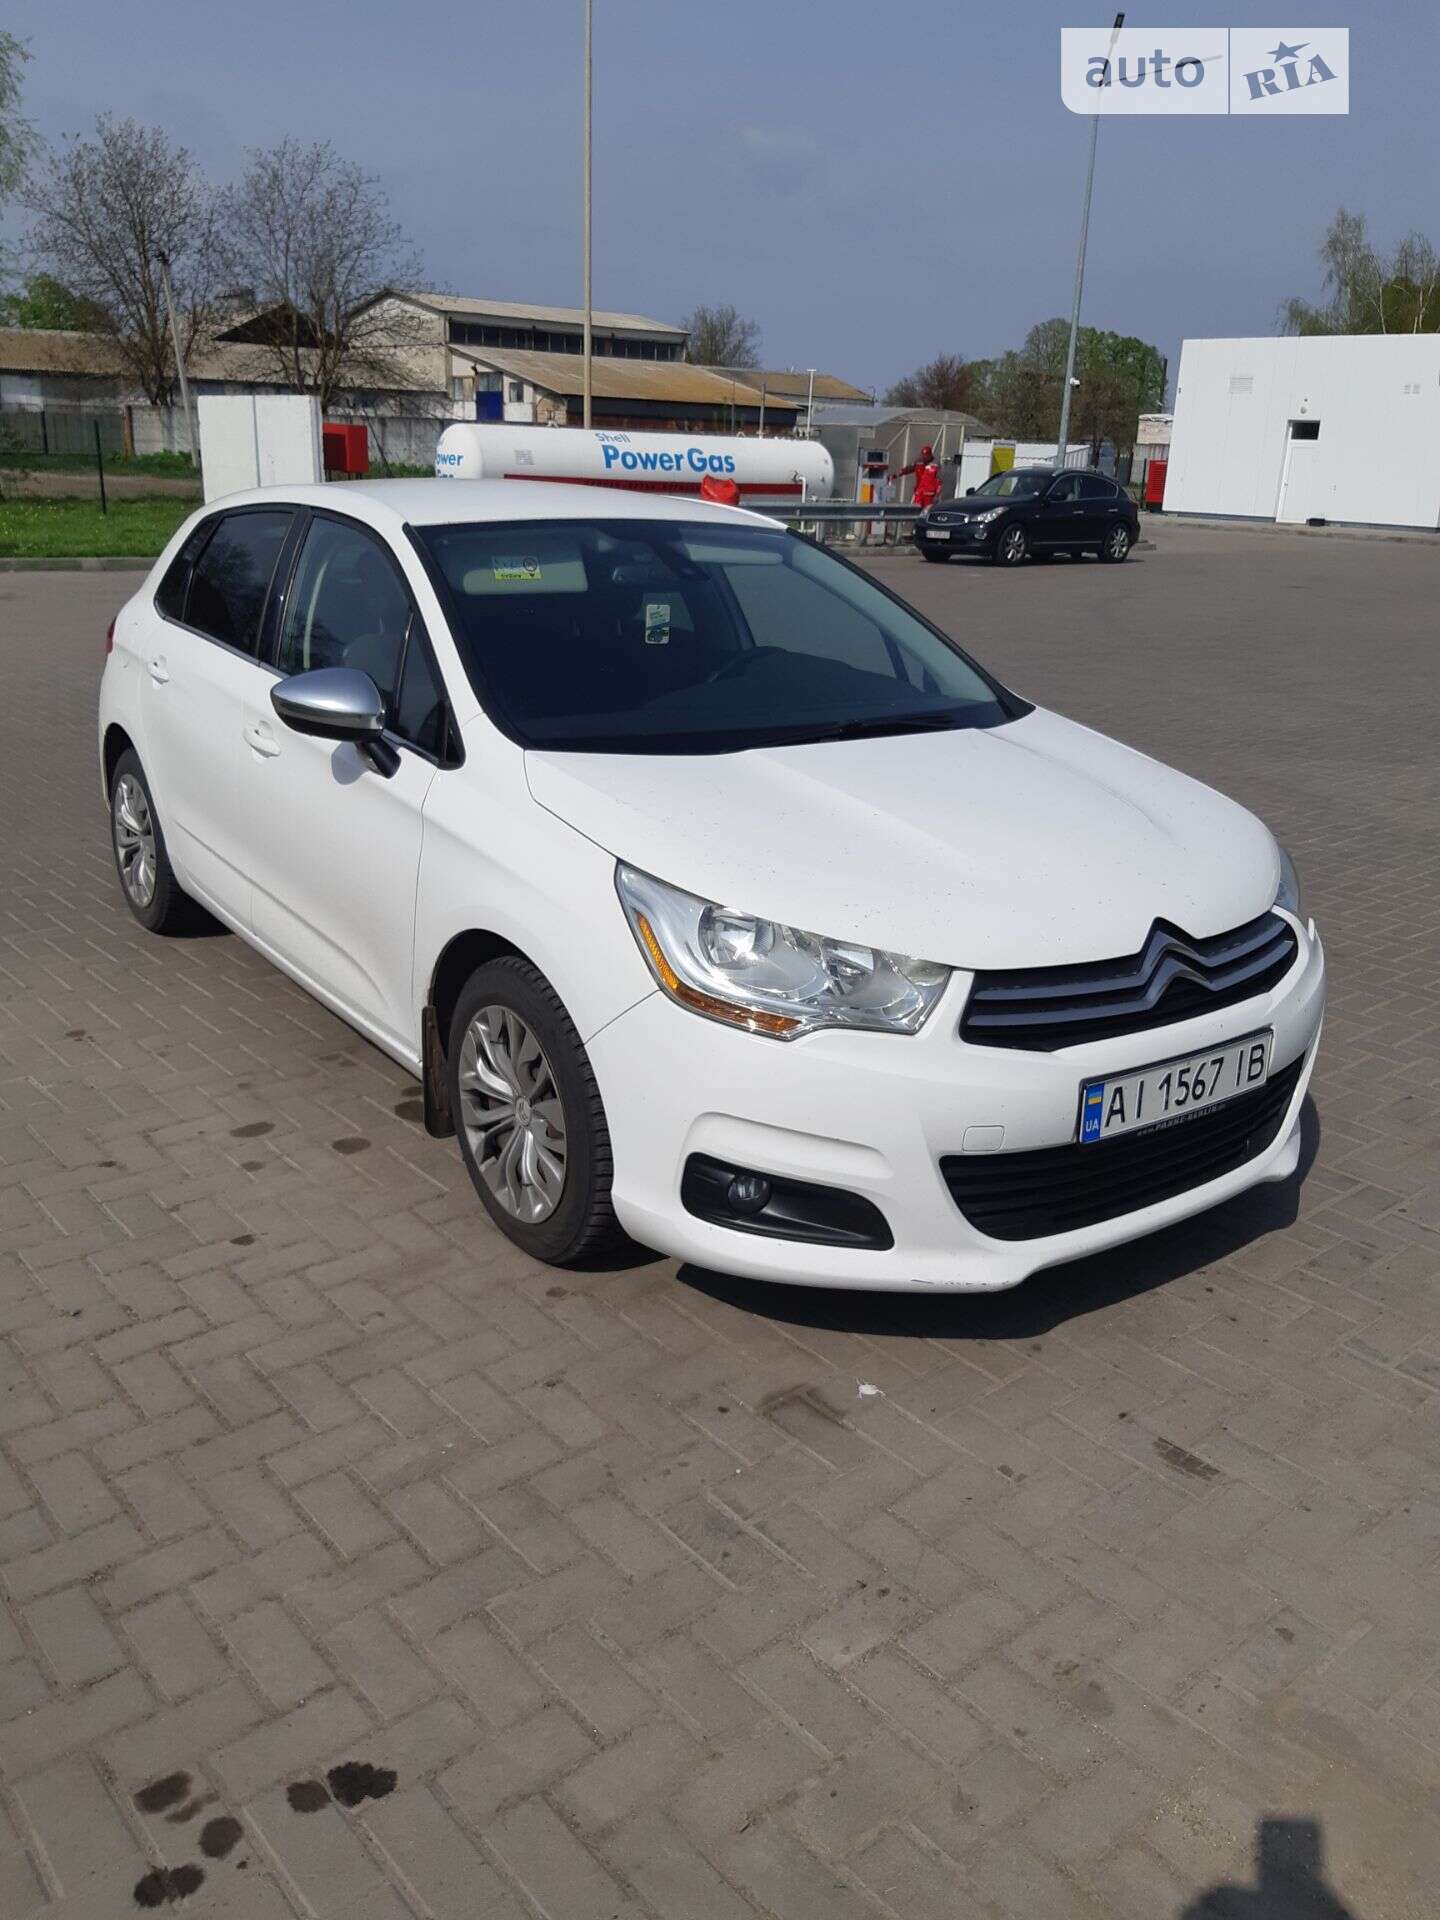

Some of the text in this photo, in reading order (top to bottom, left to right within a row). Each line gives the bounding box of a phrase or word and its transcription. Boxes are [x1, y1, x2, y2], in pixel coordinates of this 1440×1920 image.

[595, 432, 631, 443] Shell
[435, 452, 464, 466] ower
[1104, 1080, 1144, 1128] AI
[1158, 1056, 1225, 1111] 1567
[1235, 1043, 1266, 1087] IB
[1085, 1119, 1100, 1132] UA
